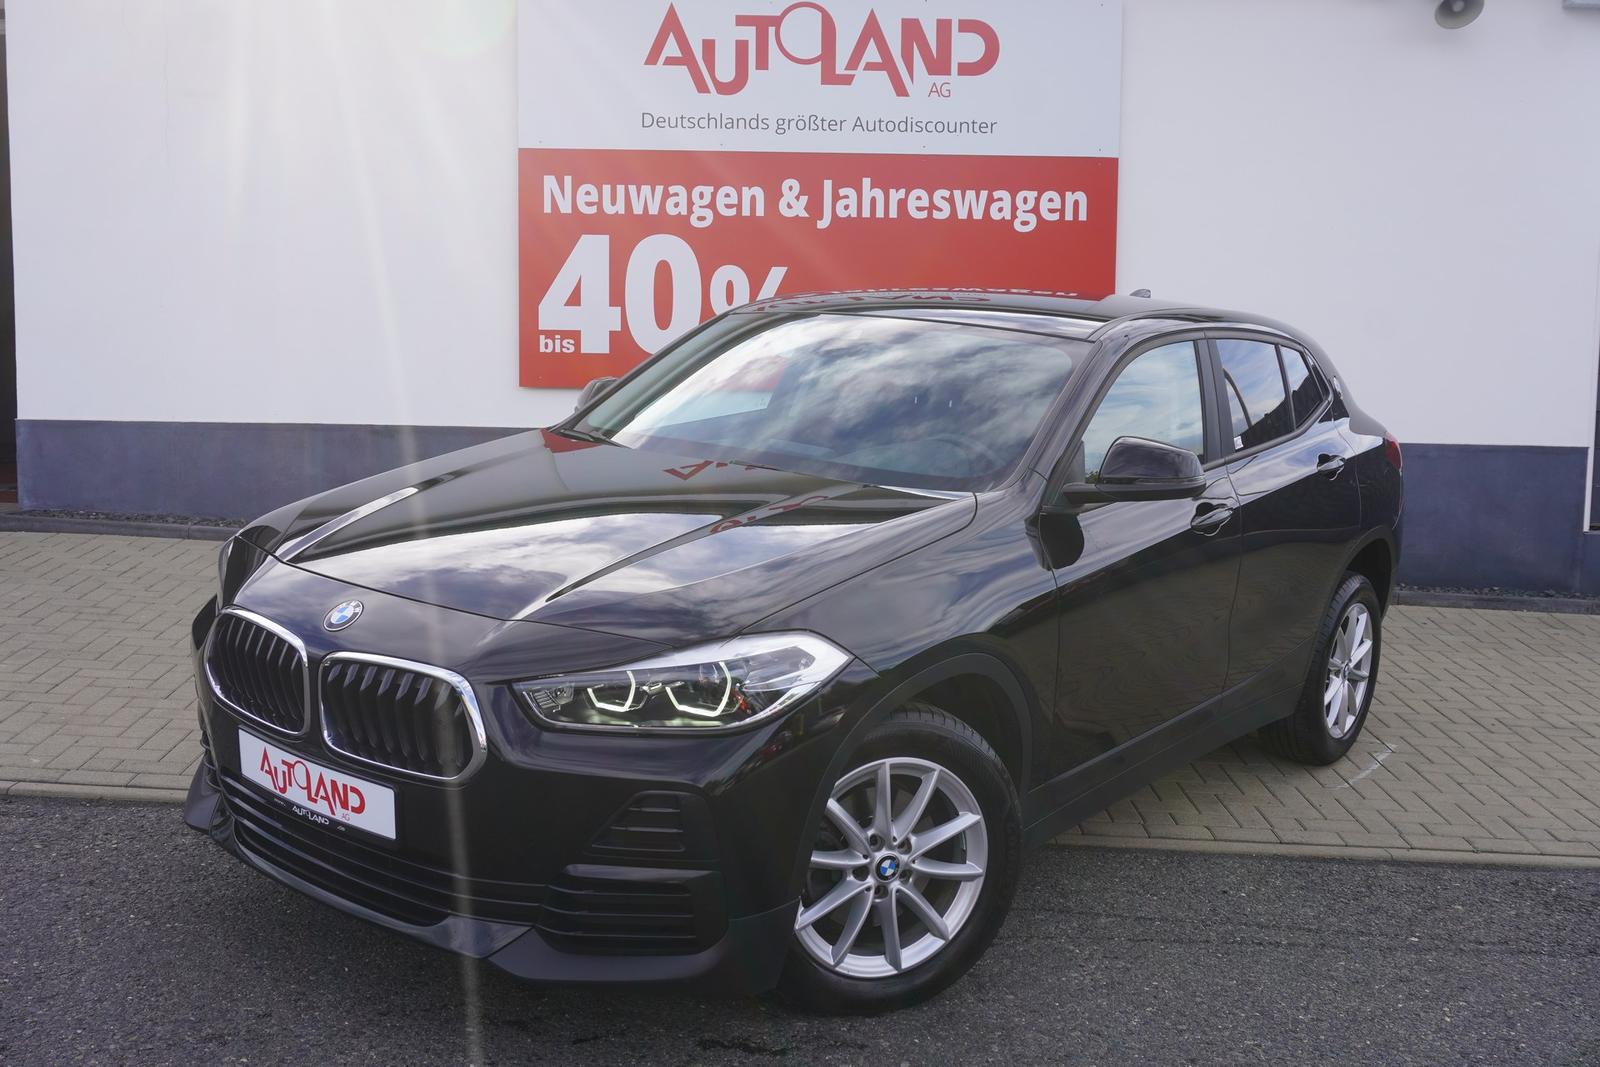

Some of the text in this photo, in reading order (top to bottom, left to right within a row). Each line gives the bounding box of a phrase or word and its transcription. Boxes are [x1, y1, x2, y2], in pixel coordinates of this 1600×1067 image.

[644, 2, 1000, 97] AUTOLAND
[928, 82, 951, 98] AG
[641, 112, 998, 136] Deutschlands größter Autodiscounter
[543, 174, 1088, 233] Neuwagen & Jahreswagen
[540, 335, 575, 354] bis
[260, 747, 366, 816] AUTOLAND
